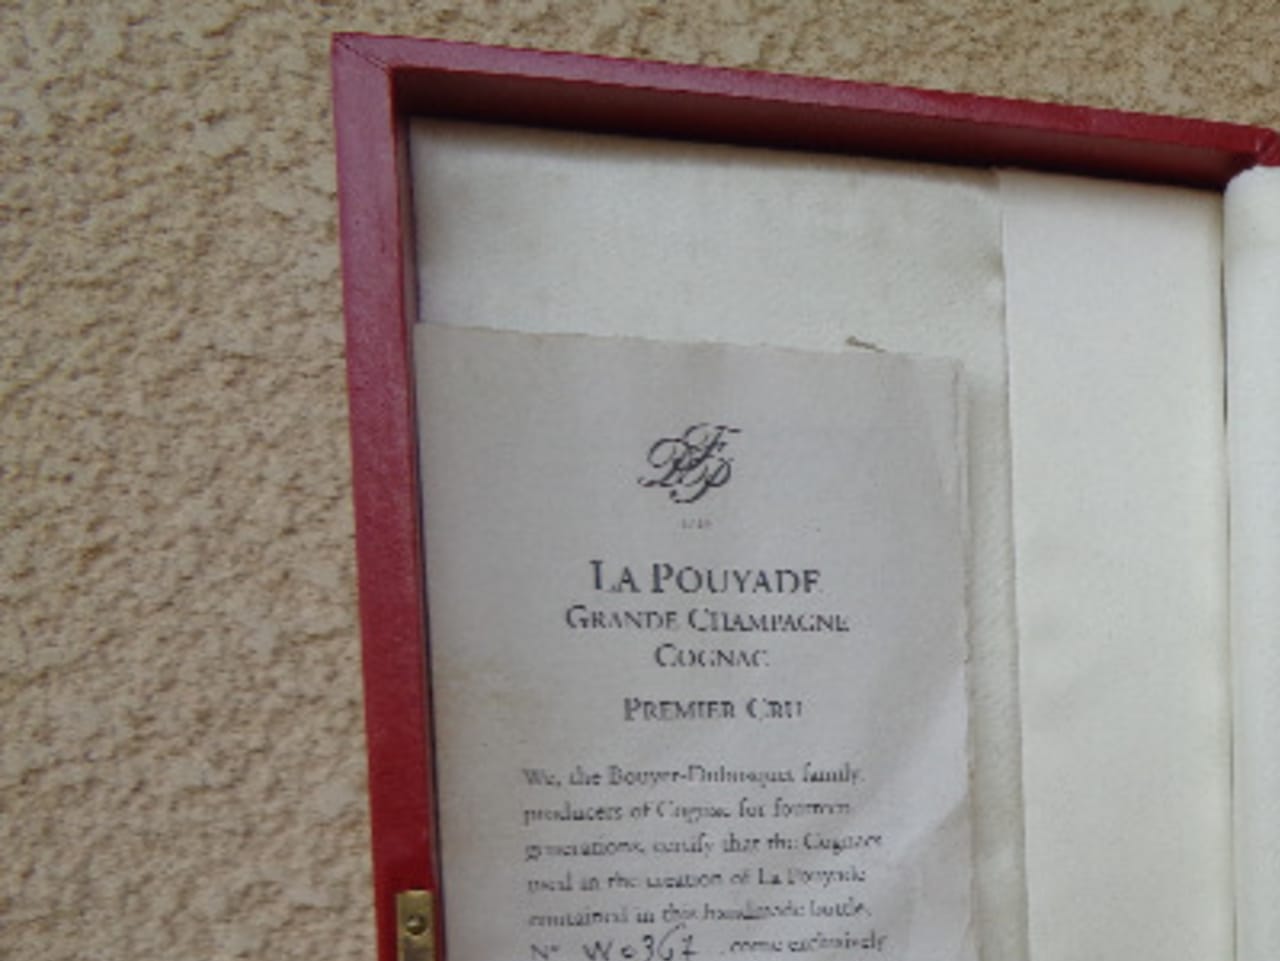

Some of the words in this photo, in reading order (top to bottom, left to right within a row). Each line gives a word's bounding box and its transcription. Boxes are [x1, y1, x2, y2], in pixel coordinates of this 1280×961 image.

[589, 559, 641, 594] LA
[651, 562, 822, 594] POUYADE
[565, 604, 678, 631] GRANDE
[688, 606, 850, 634] CHAMPAGNE
[654, 642, 771, 669] COGNAC
[623, 697, 737, 722] PREMIER
[746, 698, 803, 722] CRU
